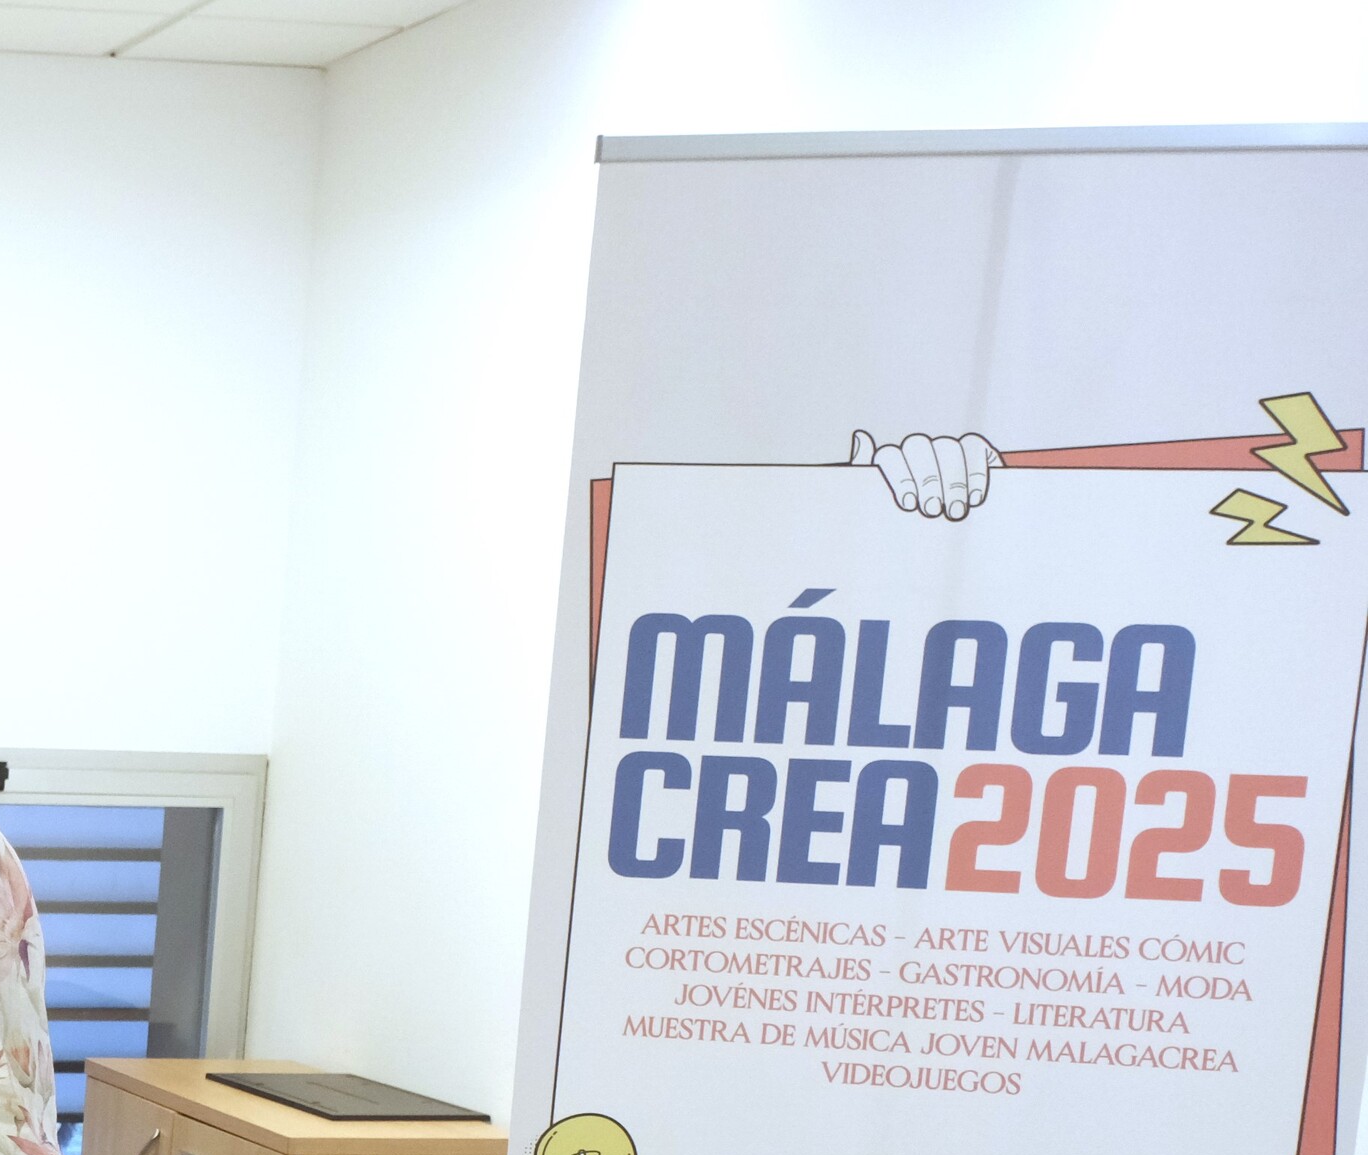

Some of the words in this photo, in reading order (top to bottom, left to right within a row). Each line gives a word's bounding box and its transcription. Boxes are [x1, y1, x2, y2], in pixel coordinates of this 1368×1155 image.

[619, 587, 1196, 758] MÁLAGA
[640, 913, 727, 939] ARTES
[734, 916, 886, 947] ESCÉNICAS
[914, 927, 989, 952] ARTE
[998, 930, 1131, 959] VISUALES
[1138, 934, 1246, 965] CÓMIC
[625, 946, 872, 981] CORTOMETRAJES
[899, 960, 1126, 995] GASTRONOMÍA
[1155, 974, 1253, 1002] MODA
[674, 982, 798, 1012] JOVÉNES
[805, 989, 985, 1023] INTÉRPRETES
[1012, 1002, 1190, 1034] LITERATURA
[622, 1015, 751, 1044] MUESTRA
[760, 1022, 796, 1046] DE
[803, 1023, 912, 1054] MÚSICA
[920, 1032, 1018, 1060] JOVEN
[1026, 1038, 1239, 1073] MALAGACREA
[821, 1061, 1021, 1095] VIDEOJUEGOS
